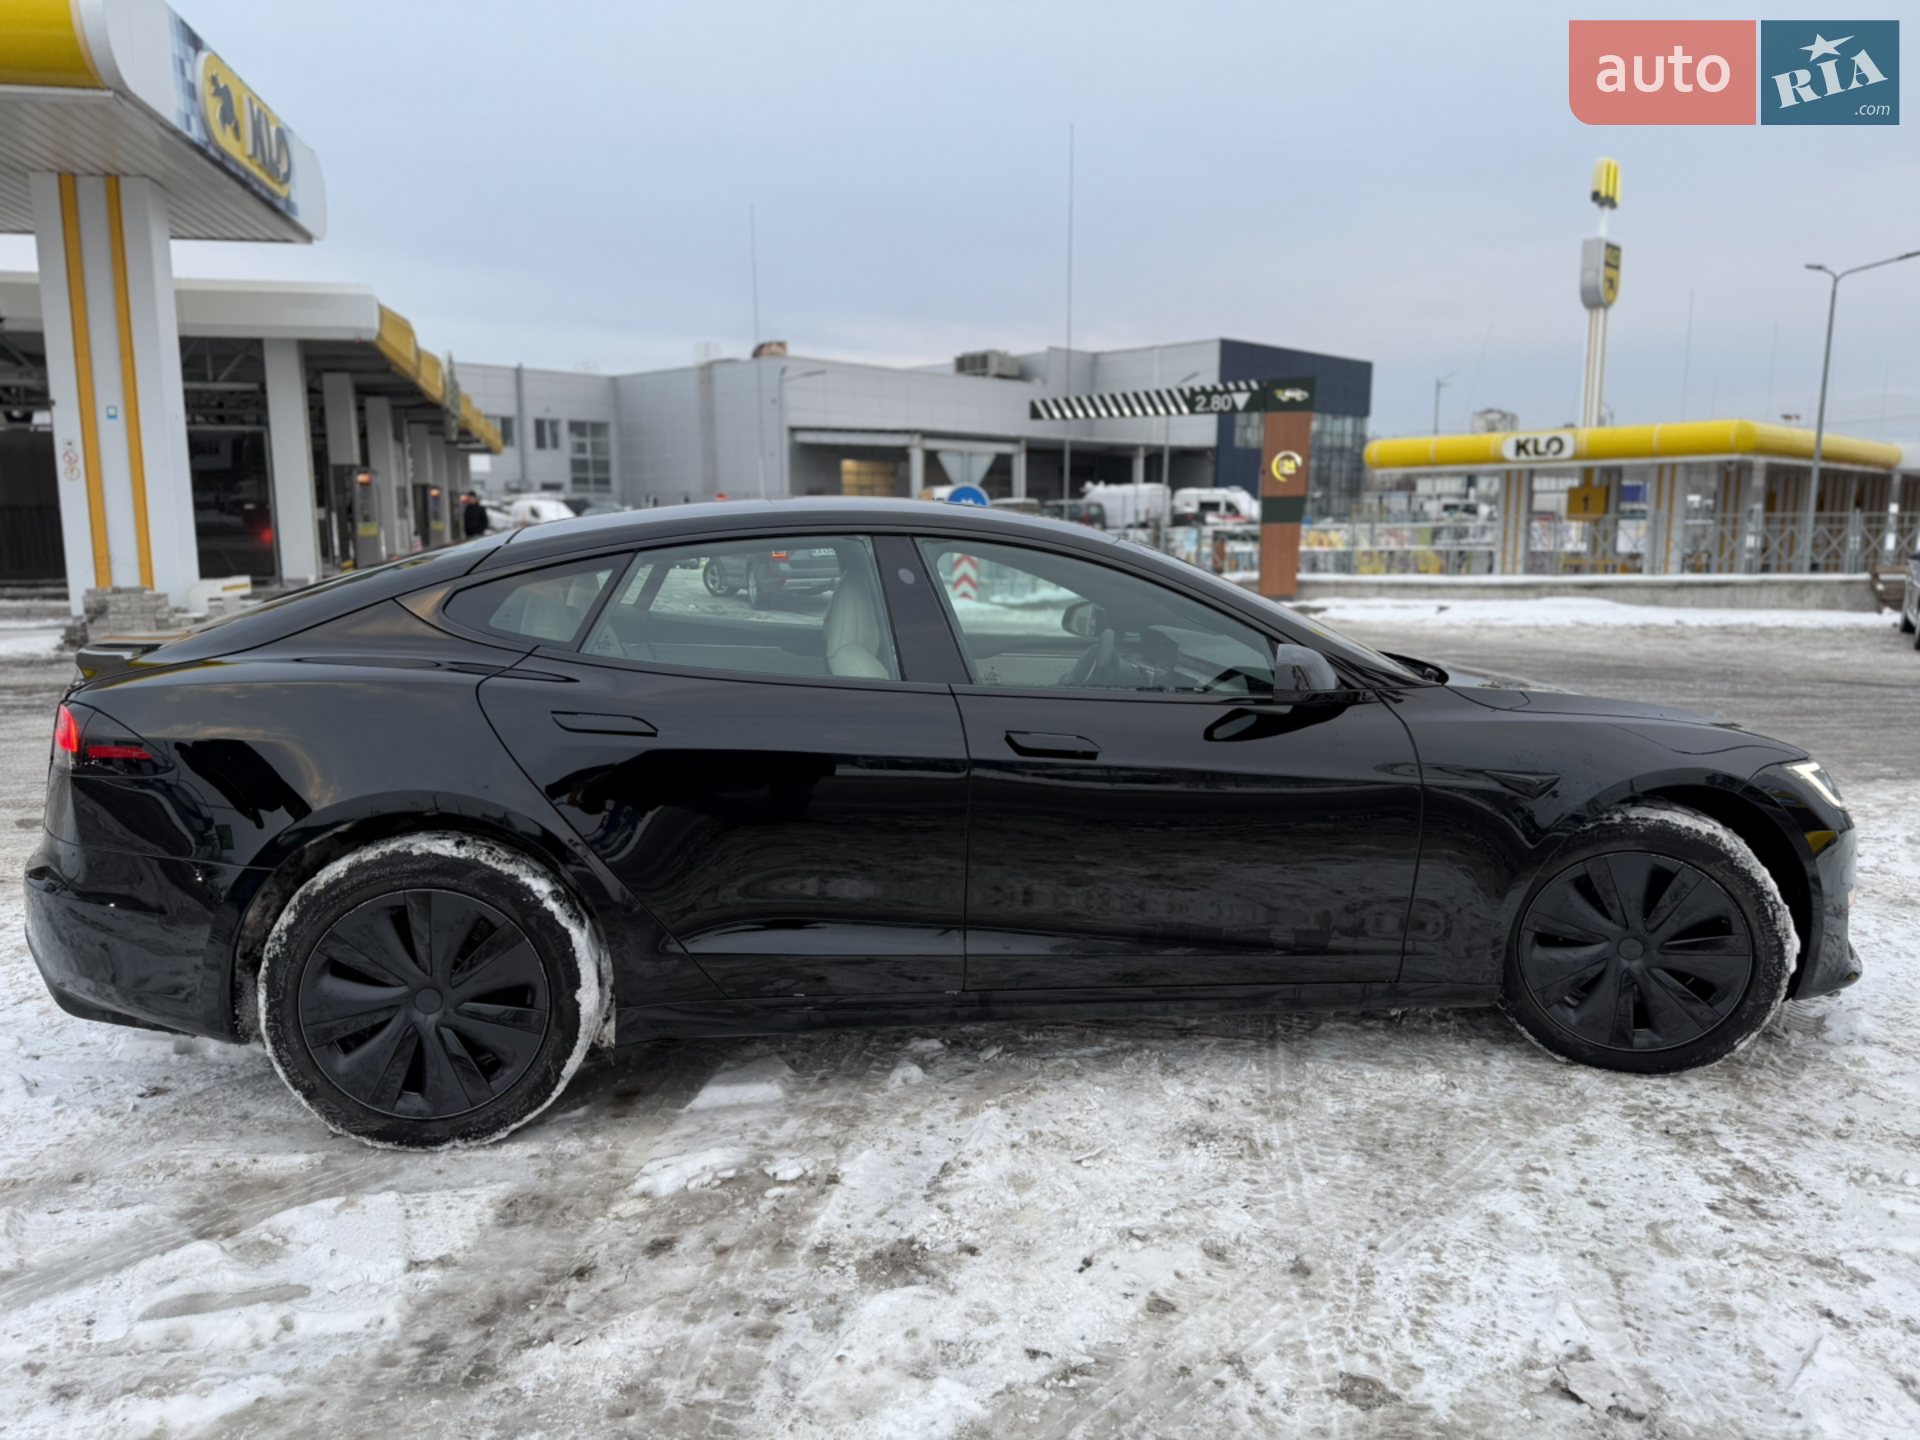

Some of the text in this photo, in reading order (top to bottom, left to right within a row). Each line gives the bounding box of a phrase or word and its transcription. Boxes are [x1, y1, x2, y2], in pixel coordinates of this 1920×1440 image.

[245, 95, 291, 184] KLO
[1194, 393, 1232, 412] 2.80
[1515, 436, 1564, 457] KLO
